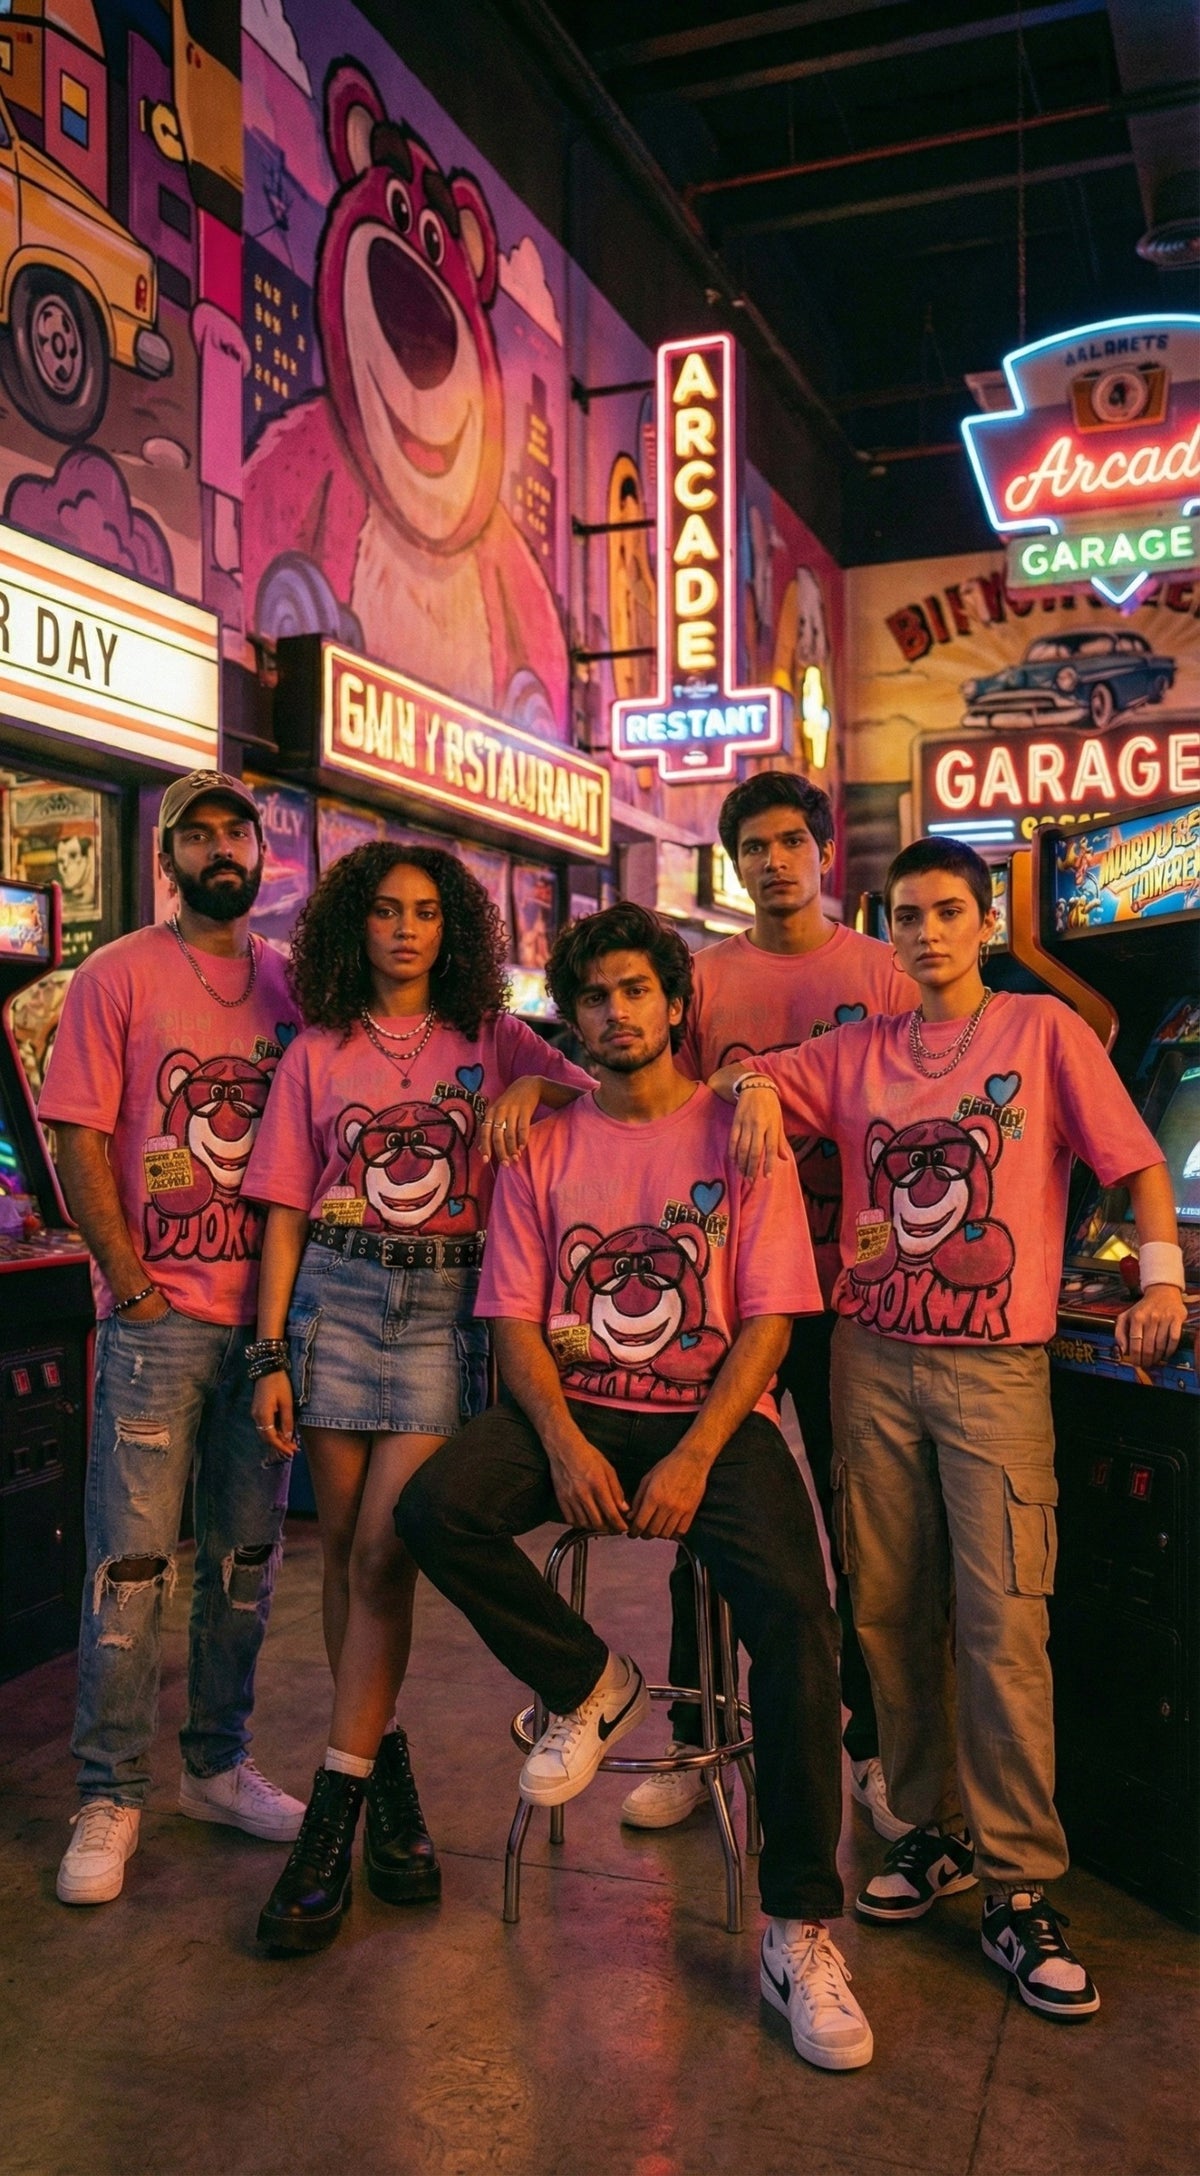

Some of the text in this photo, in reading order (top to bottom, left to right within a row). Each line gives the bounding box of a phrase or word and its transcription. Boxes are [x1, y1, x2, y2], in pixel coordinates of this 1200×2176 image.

[672, 352, 719, 672] ARCADE
[1021, 524, 1195, 576] GARAGE
[36, 605, 119, 688] DAY
[625, 704, 768, 744] RESTANT
[934, 732, 1200, 811] GARAGE
